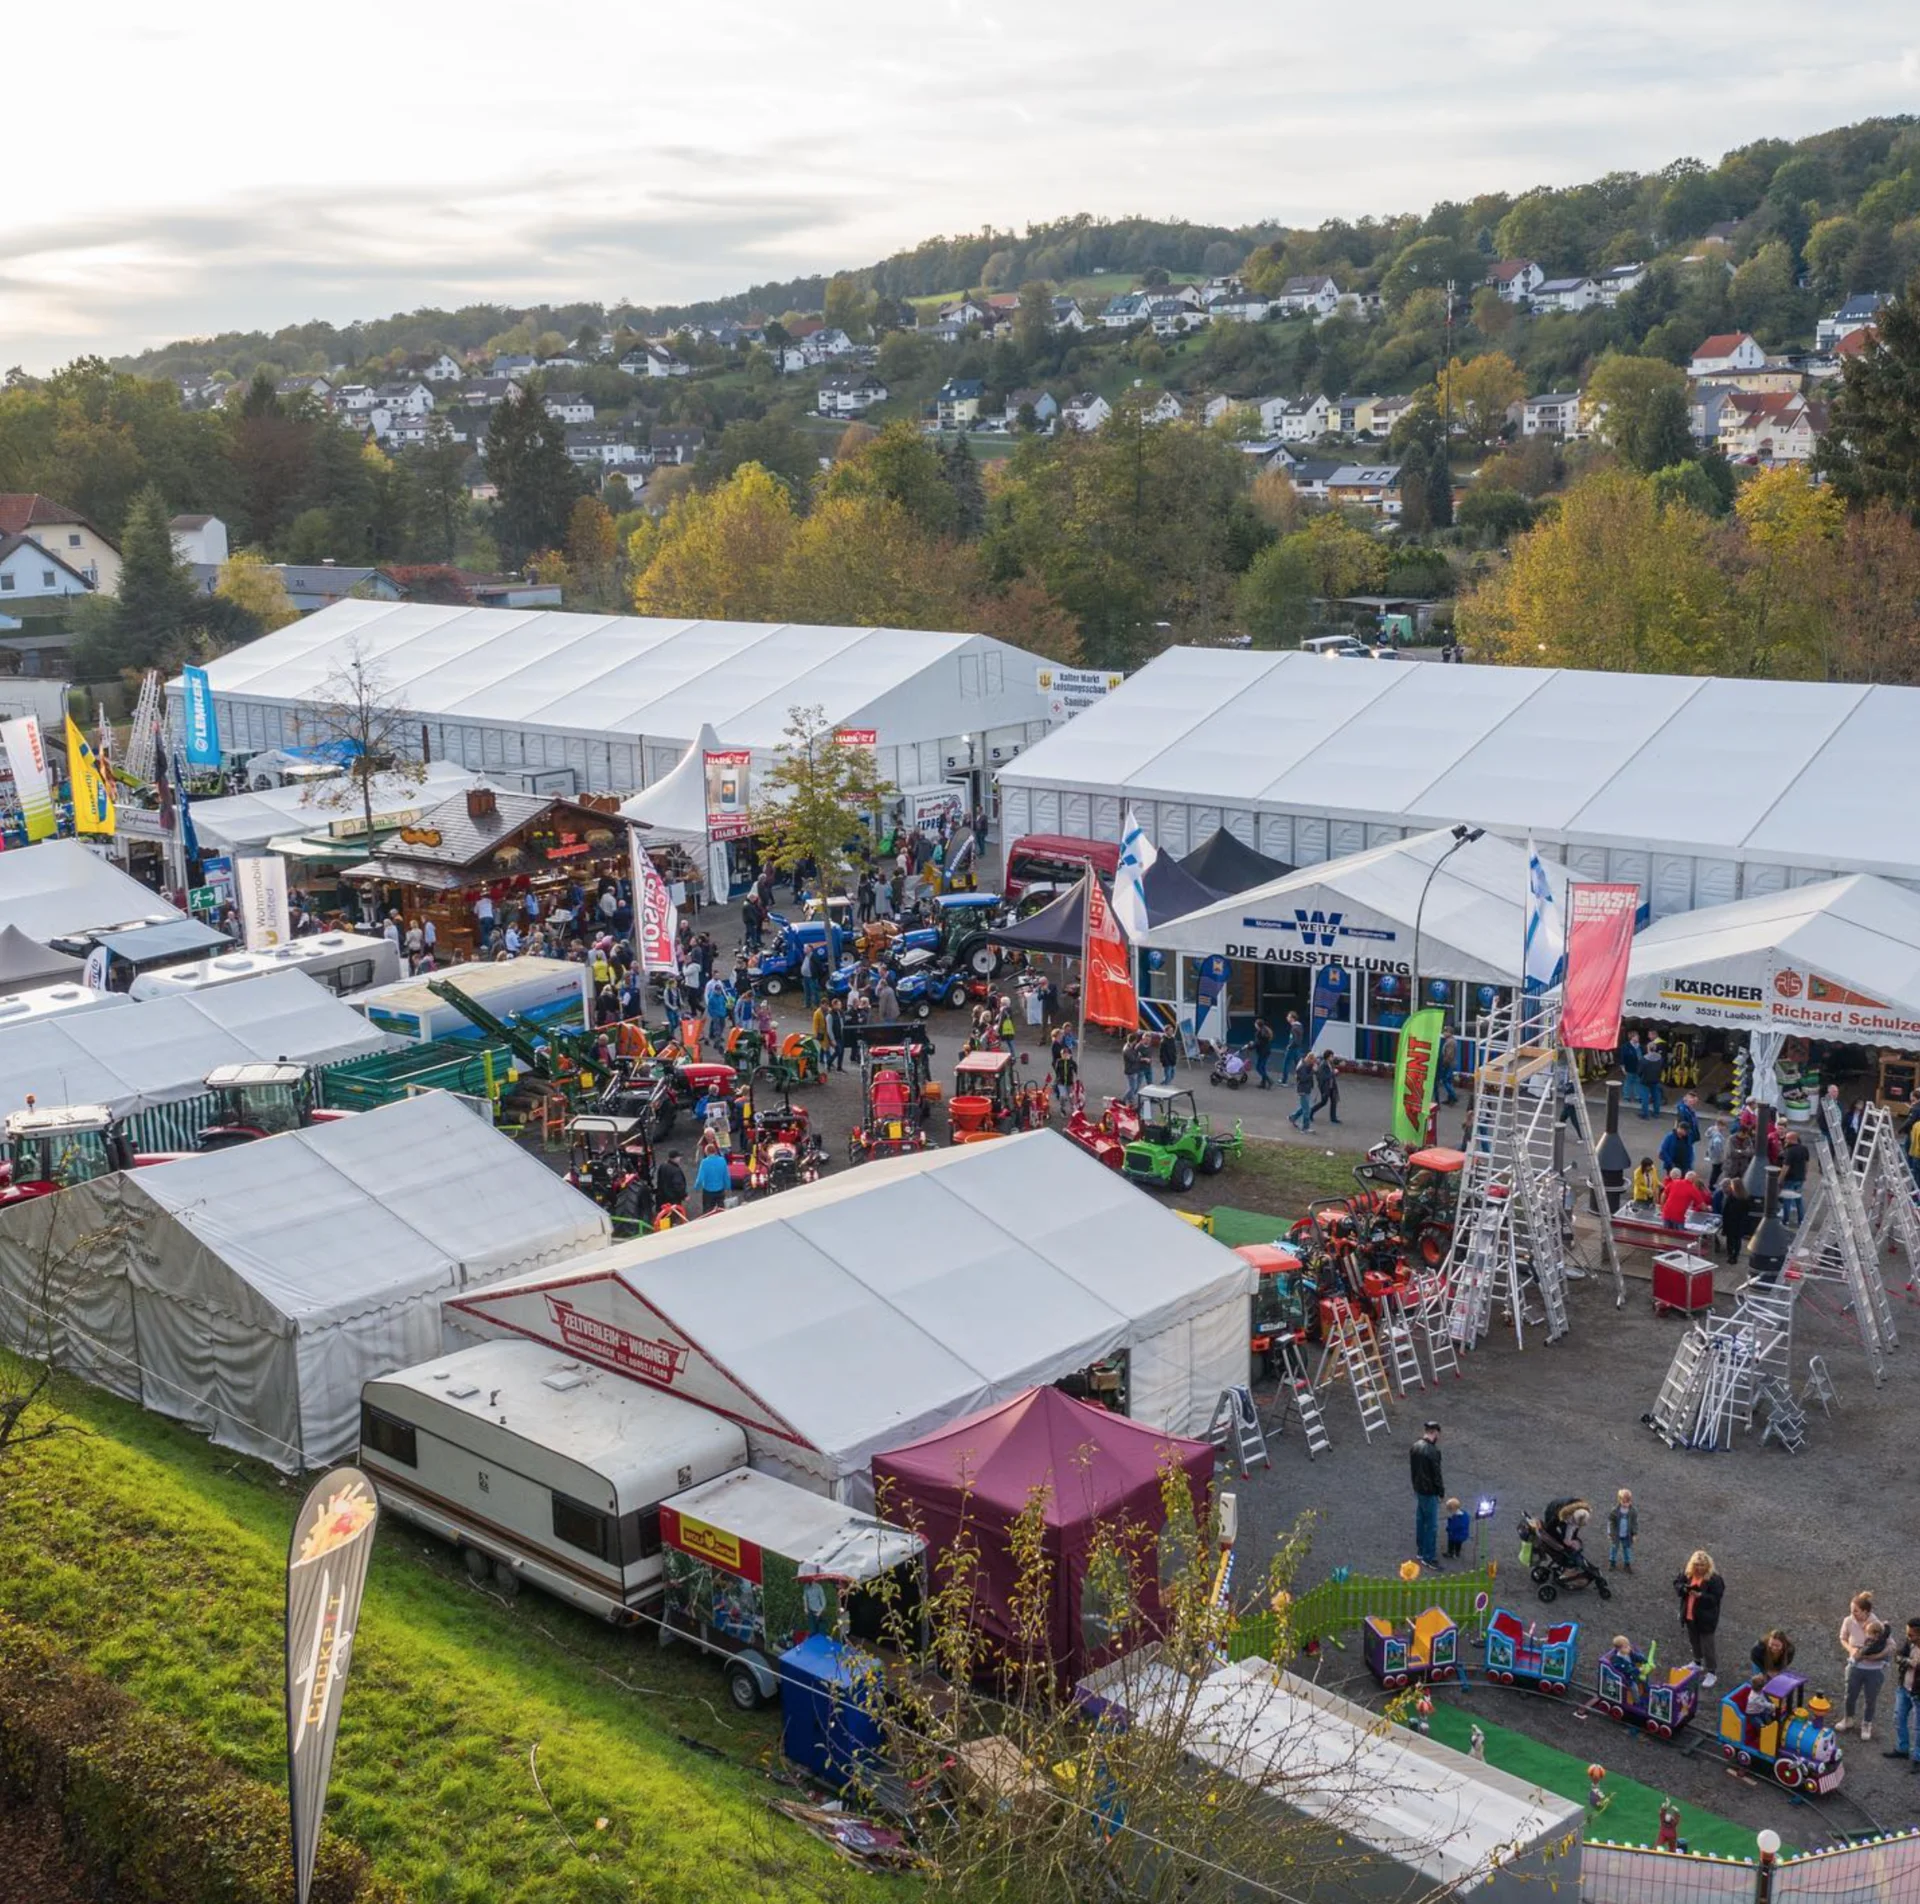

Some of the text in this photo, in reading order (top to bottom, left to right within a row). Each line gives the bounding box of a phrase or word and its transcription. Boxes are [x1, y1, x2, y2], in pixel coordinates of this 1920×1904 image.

[1053, 682, 1107, 694] Leistungsschau
[1081, 674, 1100, 684] Markt
[192, 676, 208, 738] LEMKEN
[992, 748, 1001, 758] 5
[1013, 746, 1020, 756] 5
[947, 757, 956, 768] 5
[251, 857, 266, 928] Wohnmobile
[265, 887, 277, 928] United
[1299, 922, 1337, 934] WEITZ
[1225, 944, 1411, 975] DIE AUSSTELLUNG
[1674, 979, 1763, 1001] KÄRCHER
[1625, 999, 1682, 1012] Center R+W
[1695, 1007, 1762, 1021] 35321 Laubach
[1772, 1003, 1920, 1033] Richard Schulze
[1772, 1016, 1812, 1028] Gesellschaft
[1403, 1037, 1432, 1132] AVANT
[563, 1312, 670, 1366] ZELTVERLEIH WAGNER
[306, 1594, 341, 1723] COCKPIT
